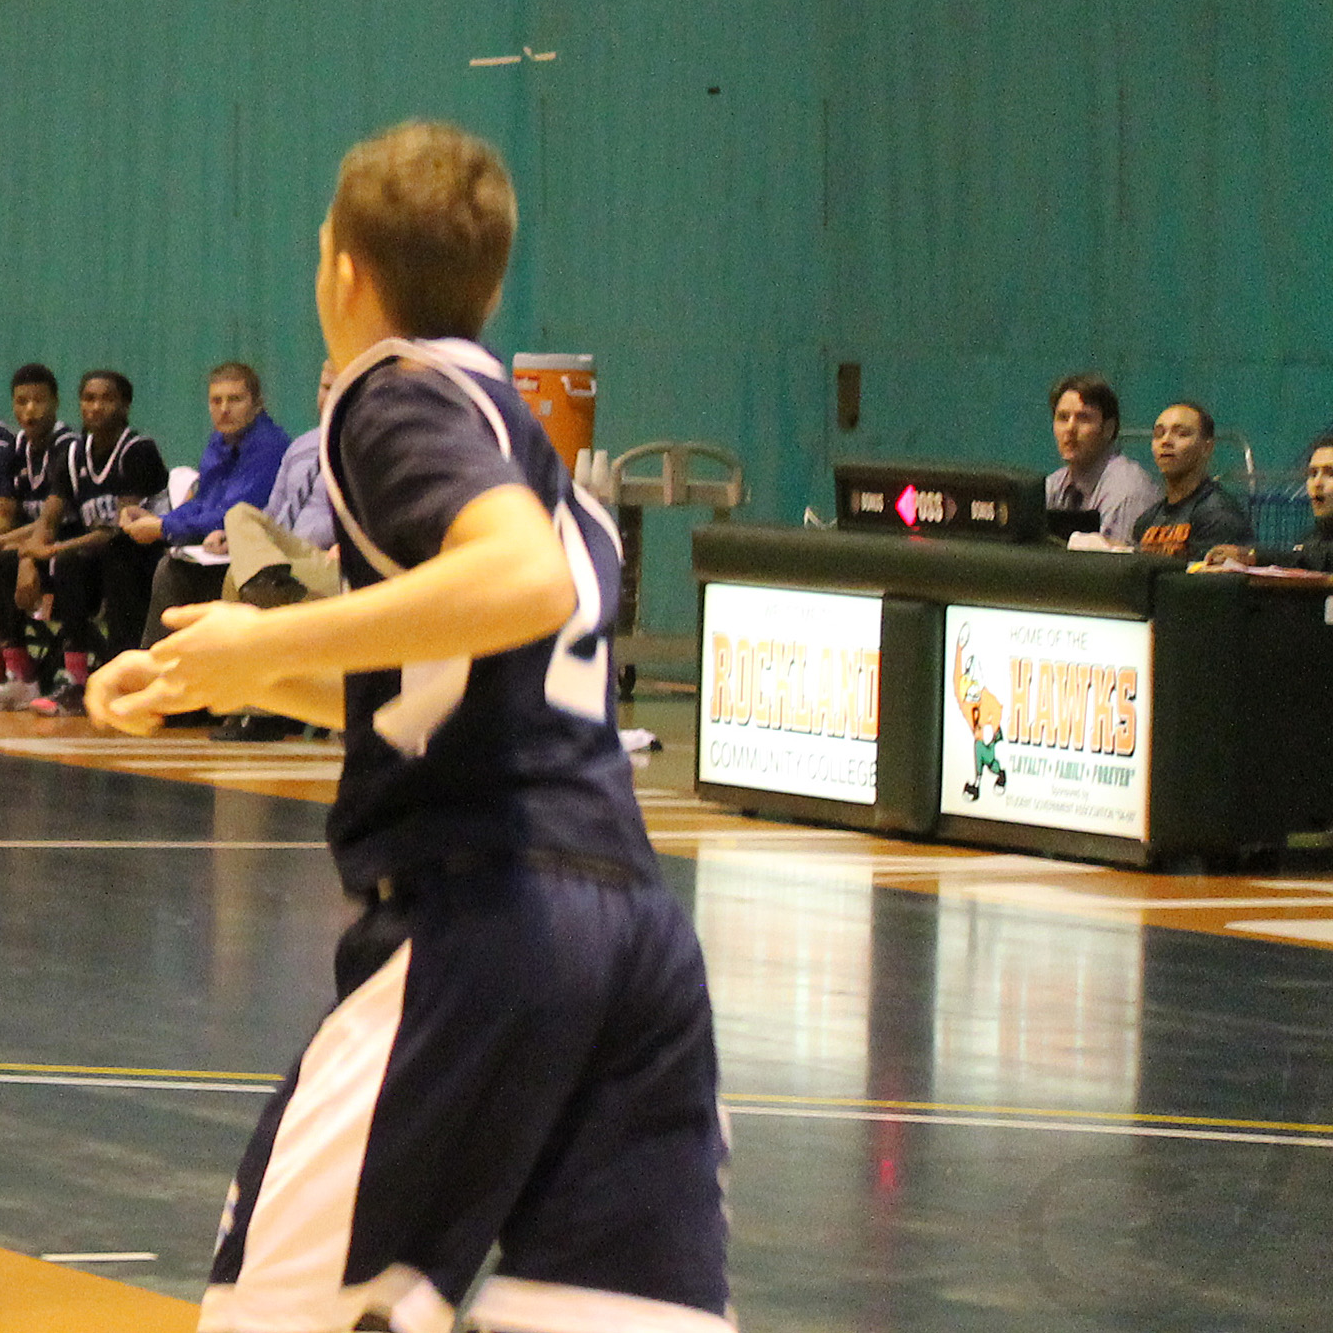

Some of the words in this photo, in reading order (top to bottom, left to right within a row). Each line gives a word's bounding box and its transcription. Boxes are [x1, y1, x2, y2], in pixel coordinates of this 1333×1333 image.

[1067, 630, 1088, 650] THE
[710, 631, 882, 742] ROCKLAND
[1008, 656, 1138, 756] HAWKS
[710, 740, 803, 778] COMMUNITY
